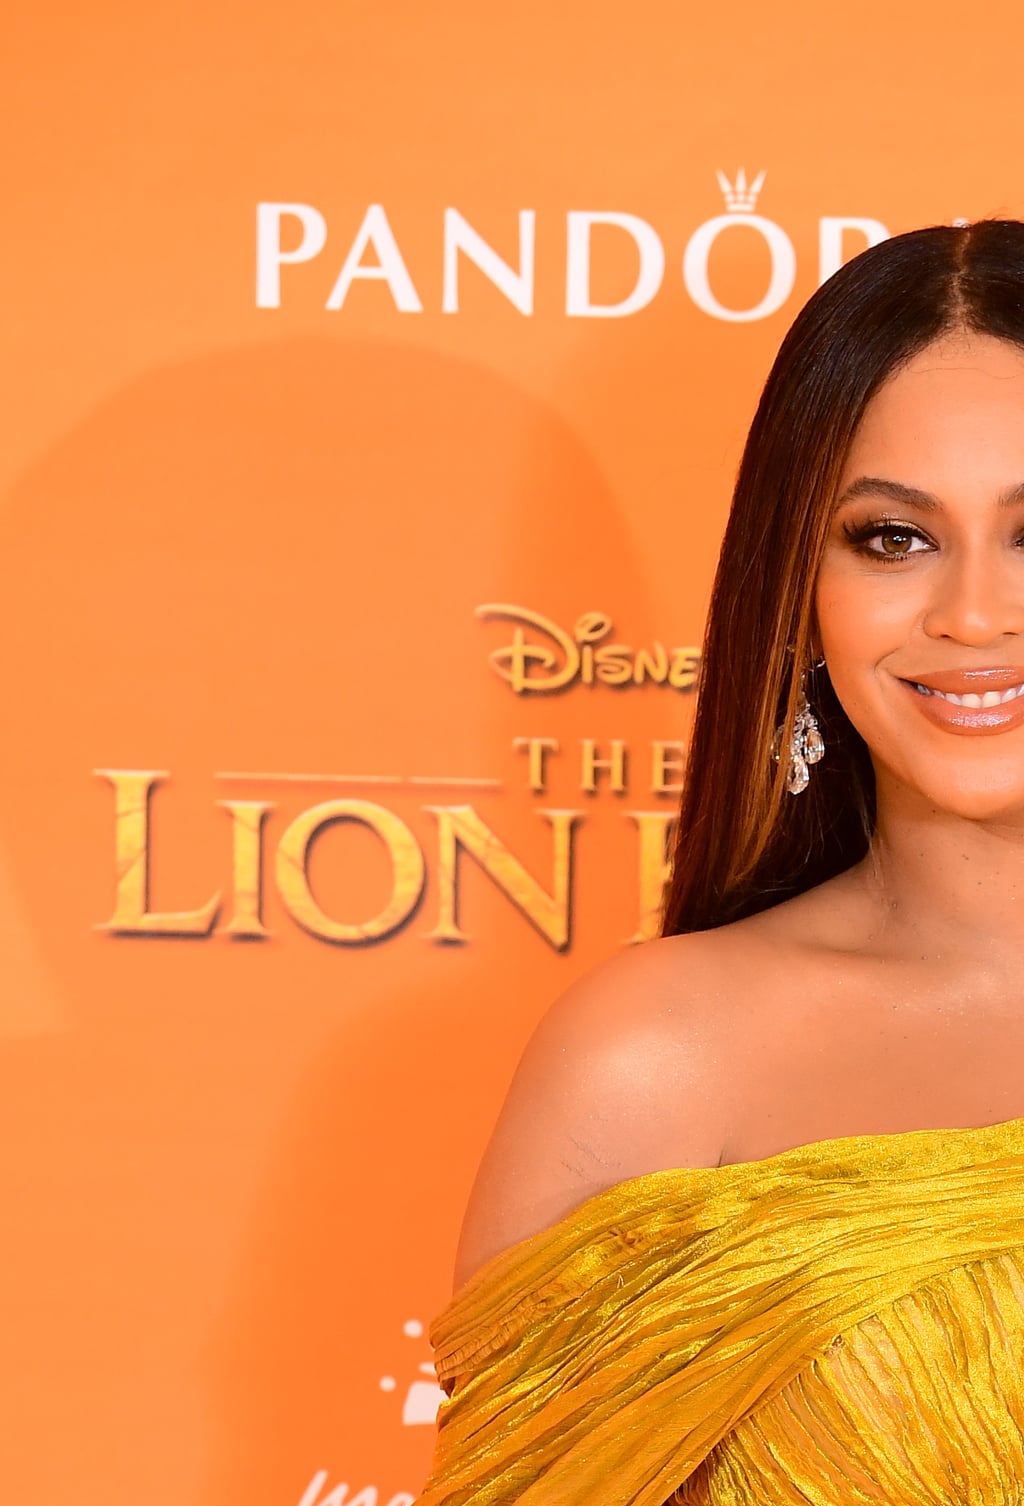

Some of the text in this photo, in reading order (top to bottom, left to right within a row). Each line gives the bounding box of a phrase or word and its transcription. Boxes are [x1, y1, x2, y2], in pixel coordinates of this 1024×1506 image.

[256, 202, 970, 323] PANDO
[512, 737, 687, 797] THE
[92, 769, 588, 953] LION
